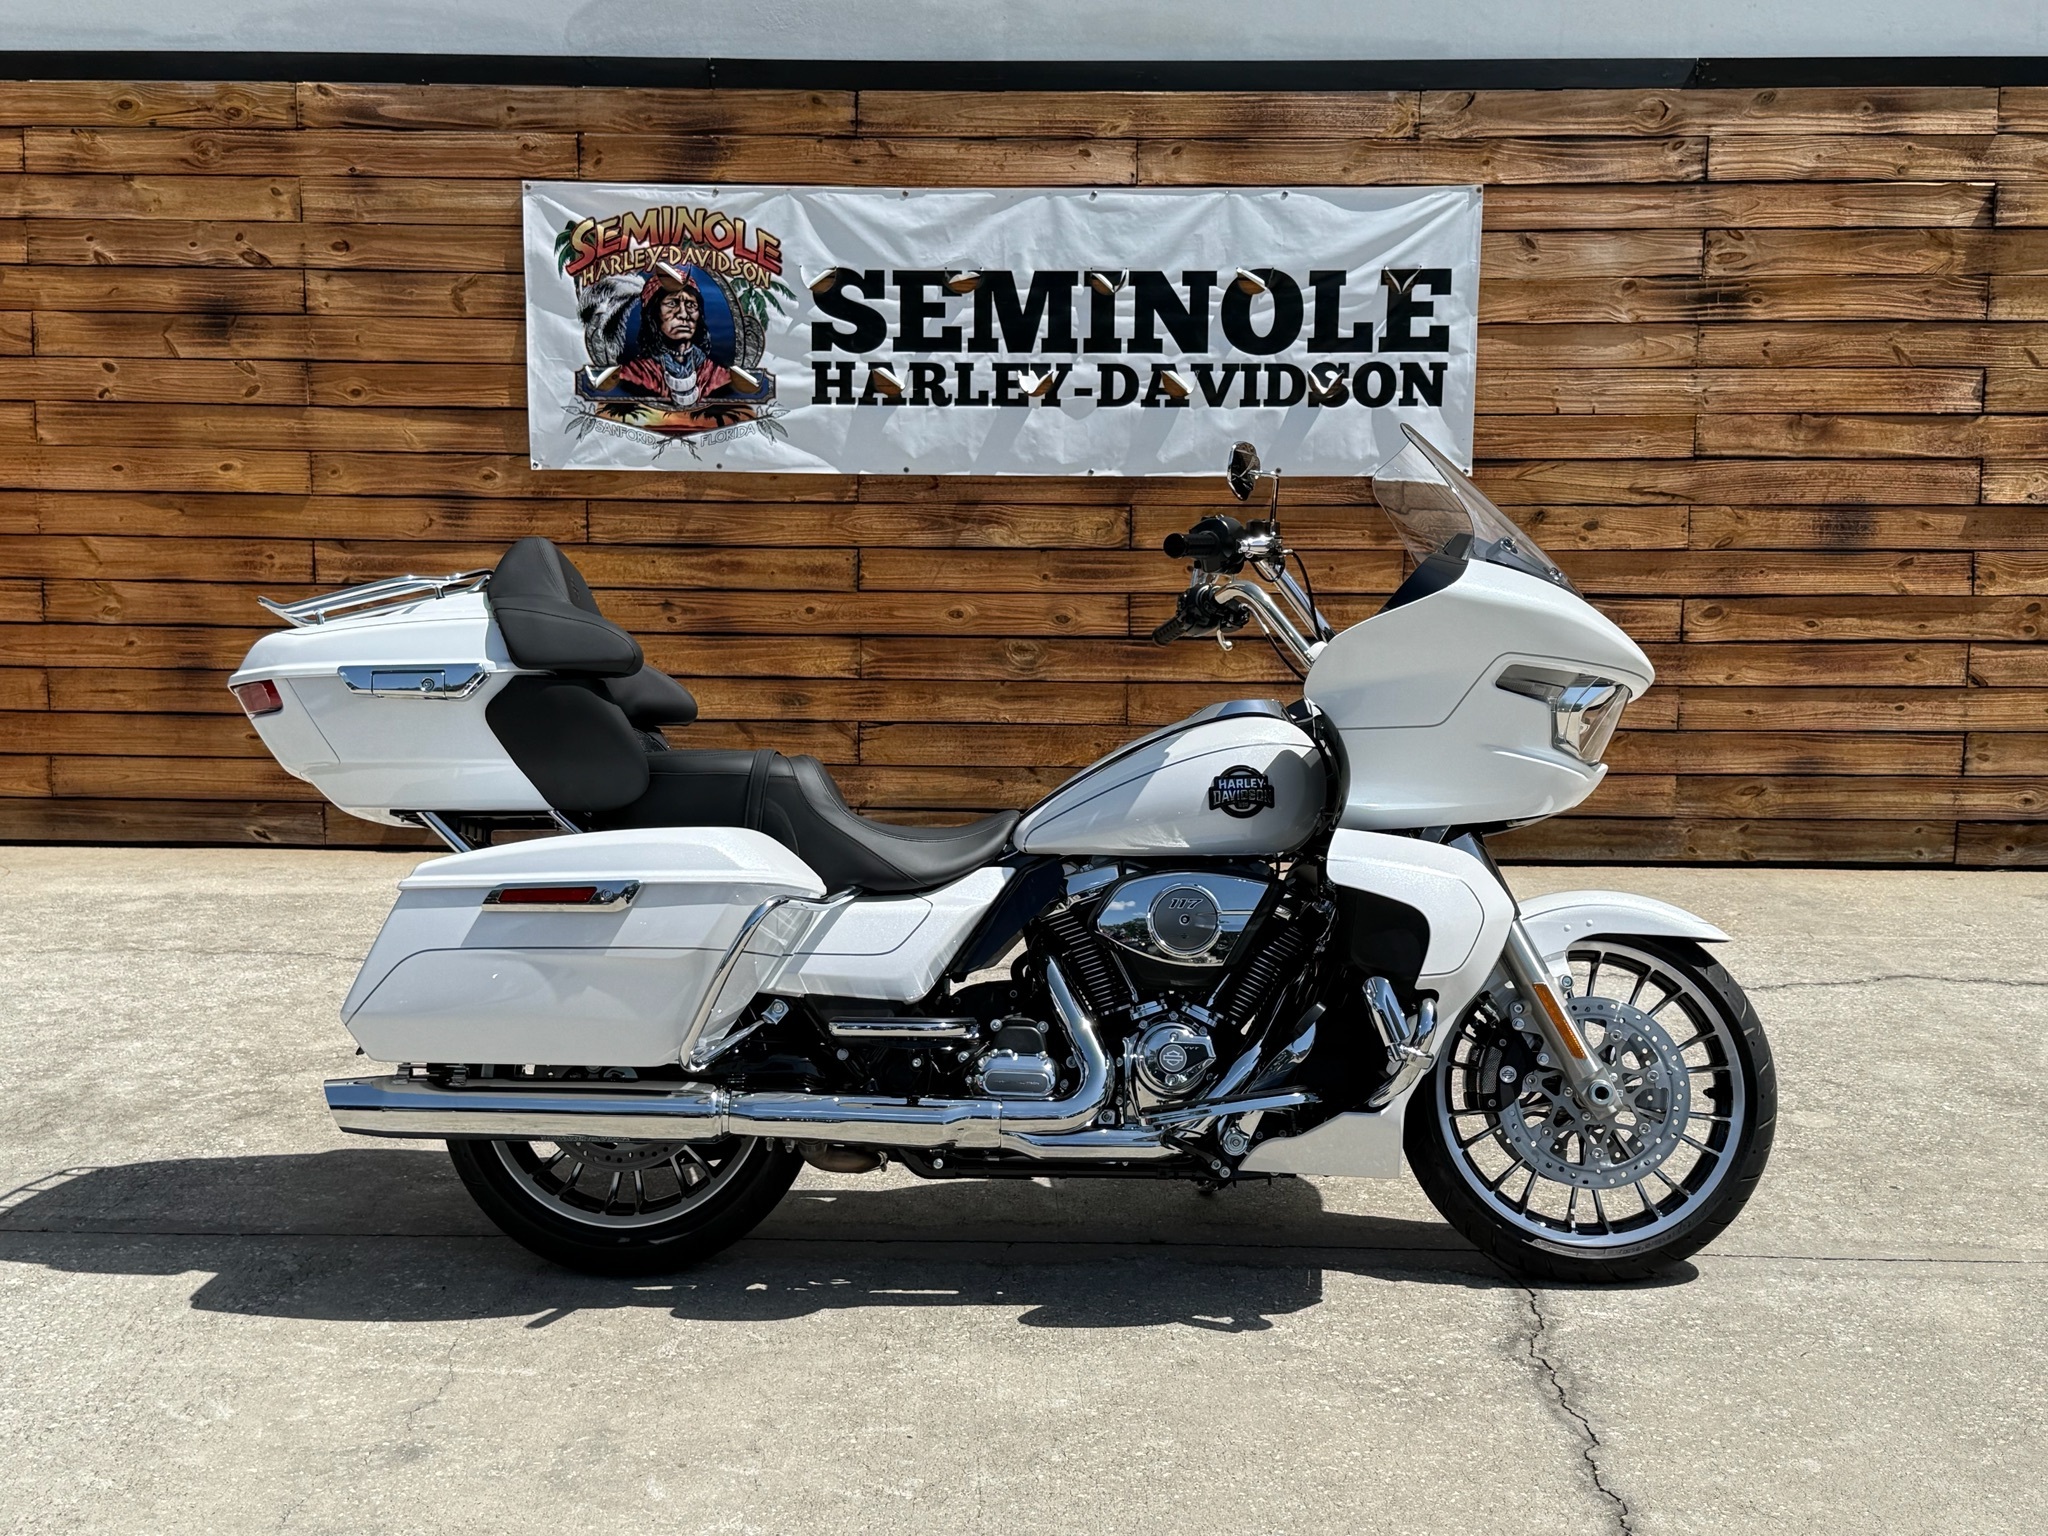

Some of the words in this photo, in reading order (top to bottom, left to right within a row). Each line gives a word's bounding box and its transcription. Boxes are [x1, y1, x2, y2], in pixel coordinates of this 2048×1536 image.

[566, 206, 782, 276] SEMINOLE
[583, 246, 773, 289] HARLEY-DAVIDSON
[811, 268, 1452, 356] SEMINOLE
[811, 361, 1448, 408] HARLEY-DAVIDSON
[700, 424, 756, 447] FLORIDA
[1213, 789, 1272, 805] DAVIDSON
[1168, 897, 1203, 909] 117
